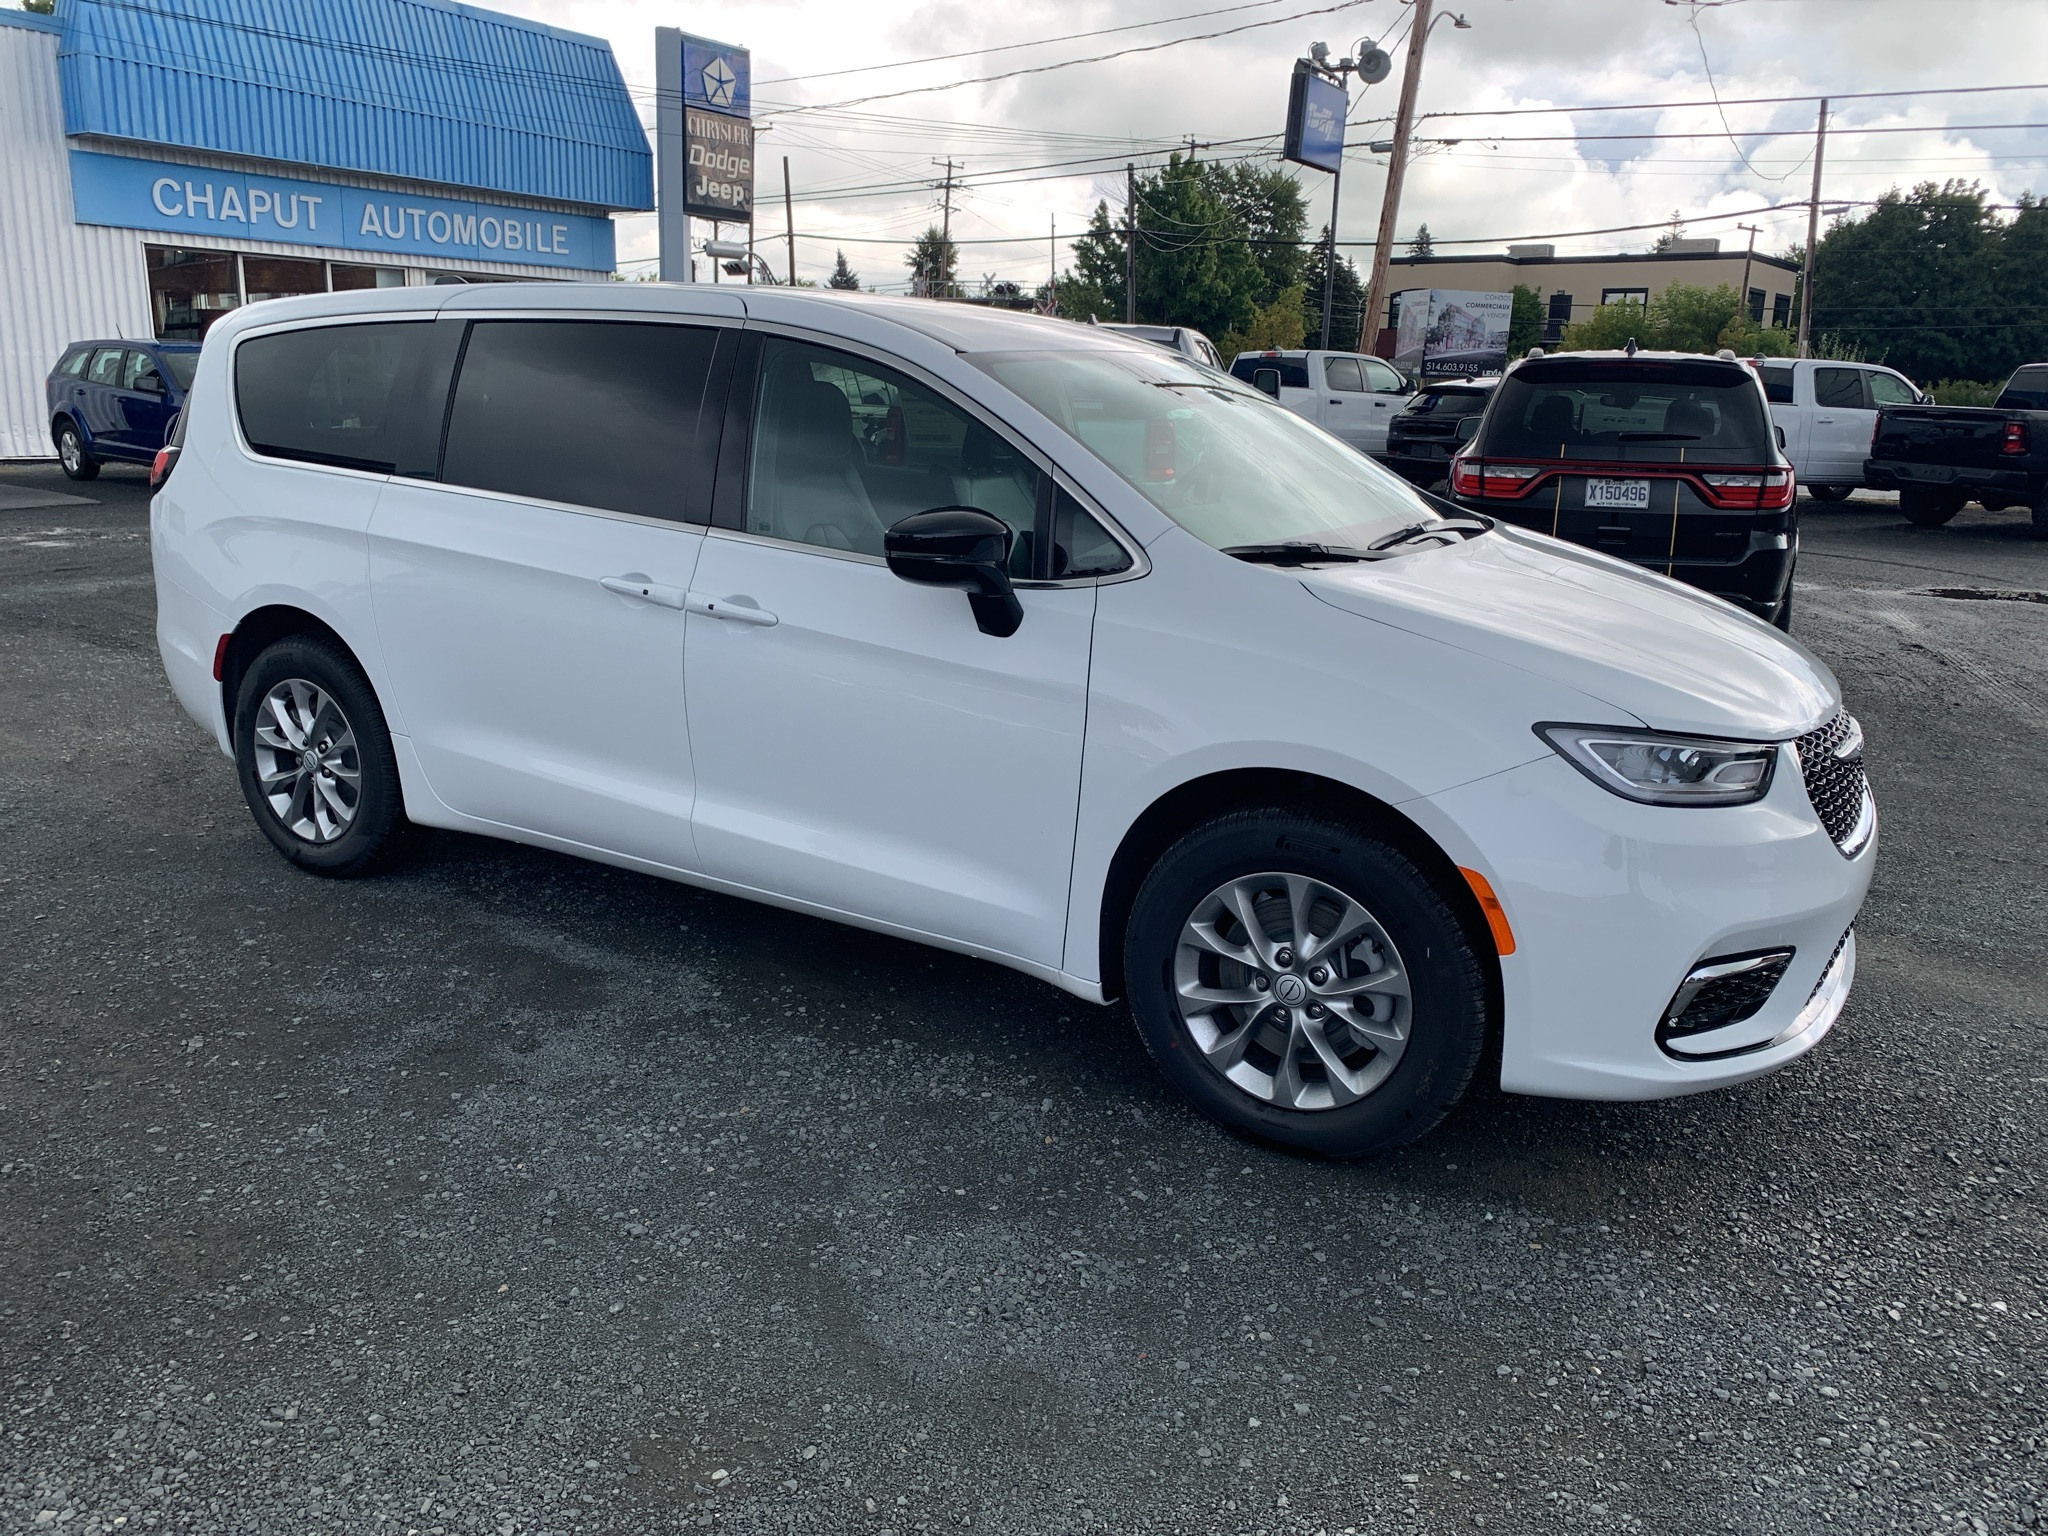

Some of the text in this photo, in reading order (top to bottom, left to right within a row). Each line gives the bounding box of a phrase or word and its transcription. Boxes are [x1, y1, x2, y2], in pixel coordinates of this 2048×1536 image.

[687, 116, 750, 147] CHRYSLER
[688, 144, 750, 179] Dodge
[696, 175, 745, 206] Jeep
[151, 177, 570, 256] CHAPUT AUTOMOBILE
[1465, 302, 1511, 310] COMMERCIAUX
[1485, 294, 1511, 302] CONDOS
[1425, 362, 1479, 372] 514.603.9155
[1588, 485, 1647, 501] X150496
